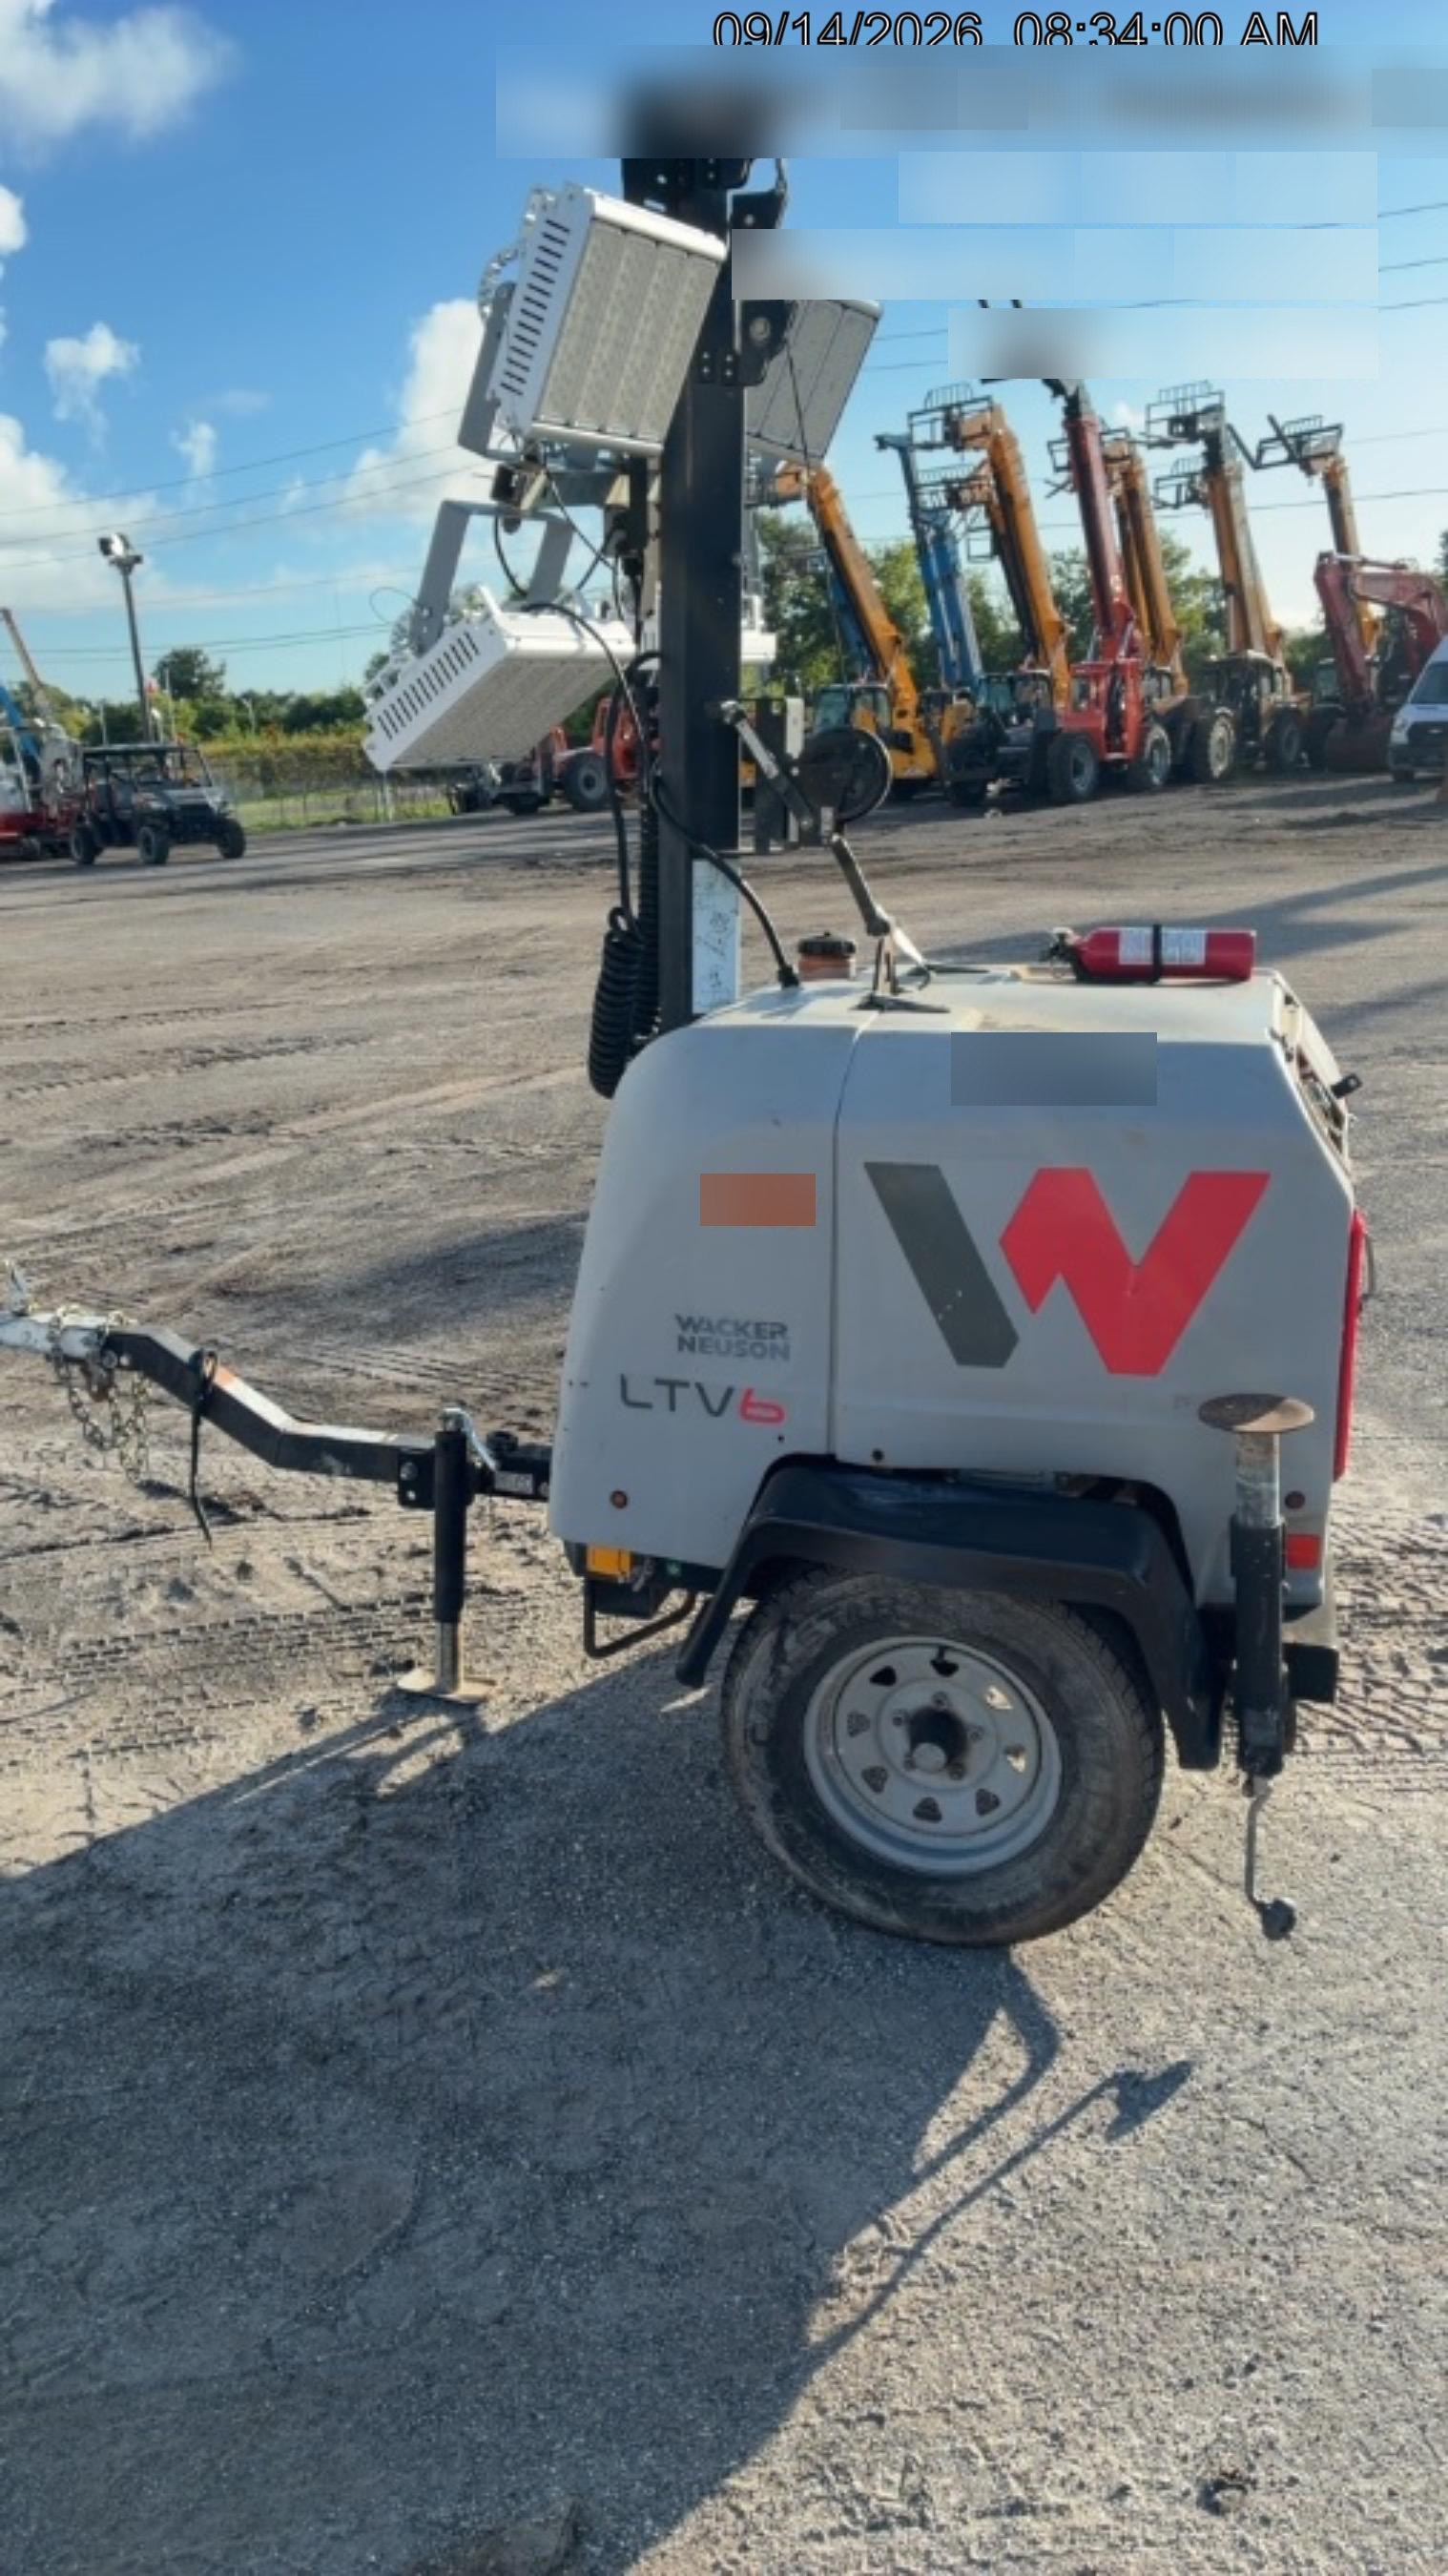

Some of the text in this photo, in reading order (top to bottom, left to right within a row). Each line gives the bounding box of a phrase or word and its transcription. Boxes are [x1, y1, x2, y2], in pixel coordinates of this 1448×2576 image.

[675, 1314, 788, 1340] WACKER
[677, 1337, 790, 1361] NEUSON
[620, 1374, 786, 1424] LTV6
